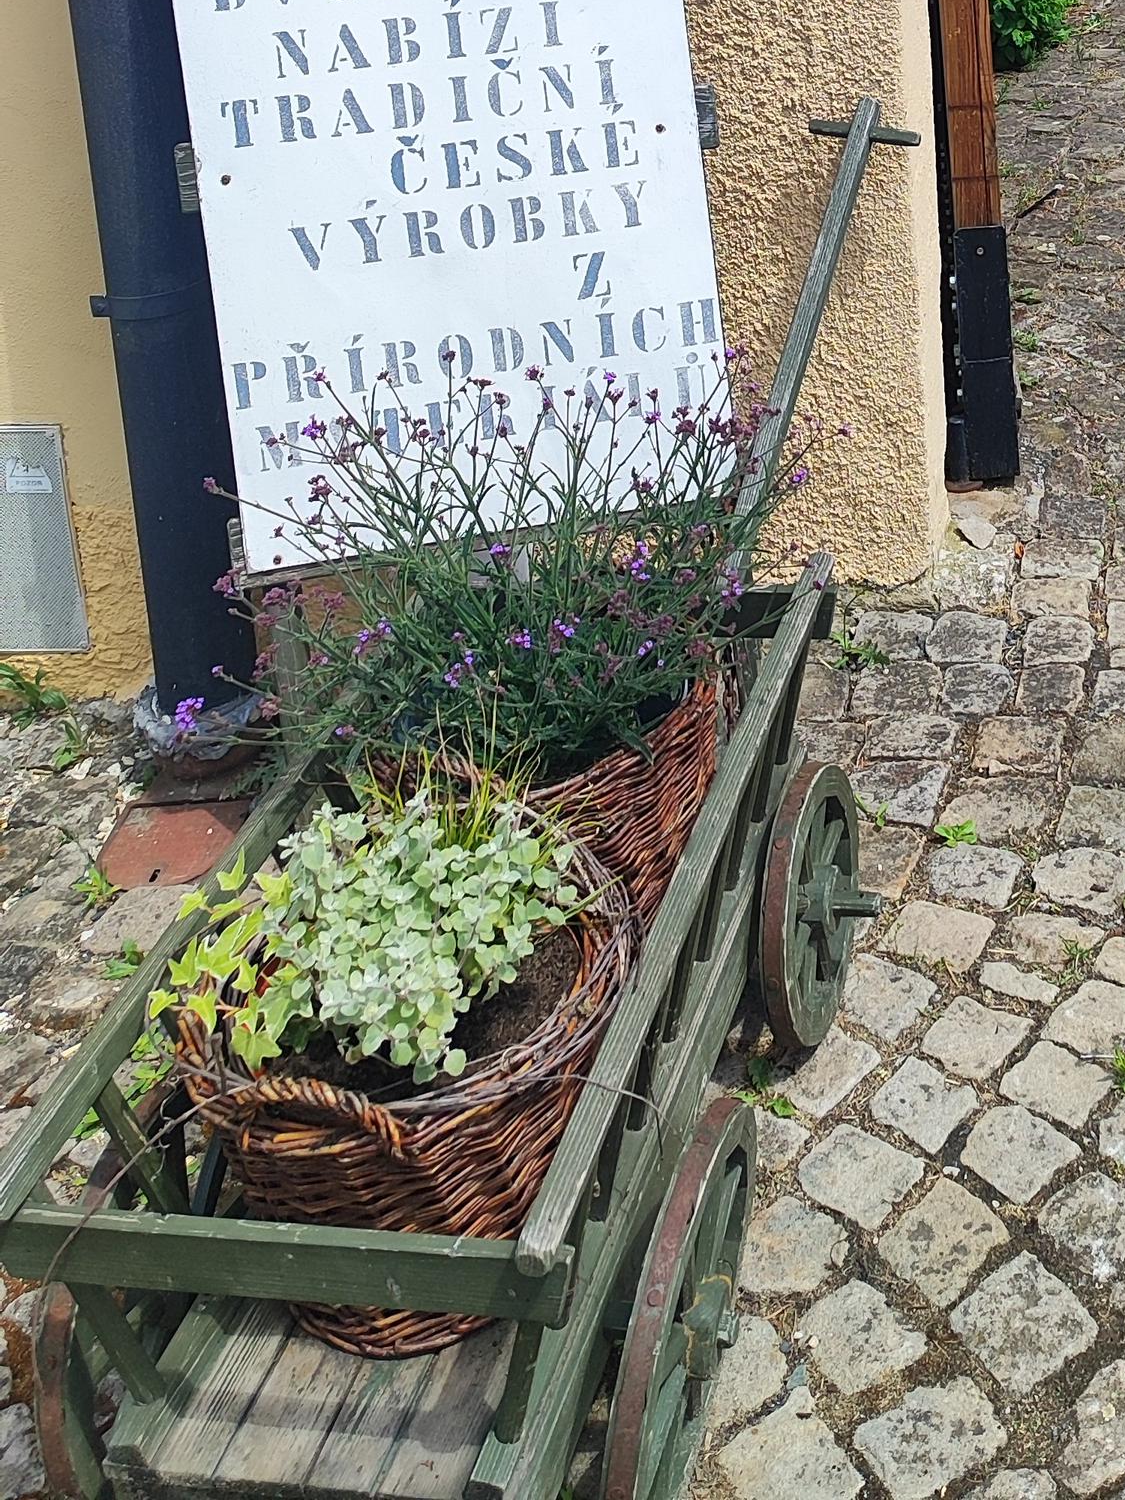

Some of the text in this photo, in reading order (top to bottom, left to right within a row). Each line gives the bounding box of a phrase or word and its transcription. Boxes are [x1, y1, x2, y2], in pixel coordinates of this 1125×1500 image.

[220, 45, 625, 148] TRADIČNÍ
[390, 104, 640, 196] ČESKÉ
[288, 180, 648, 271] VÝROBKY
[572, 250, 612, 301] Z
[231, 297, 720, 411] PŘÍRODNÍCH
